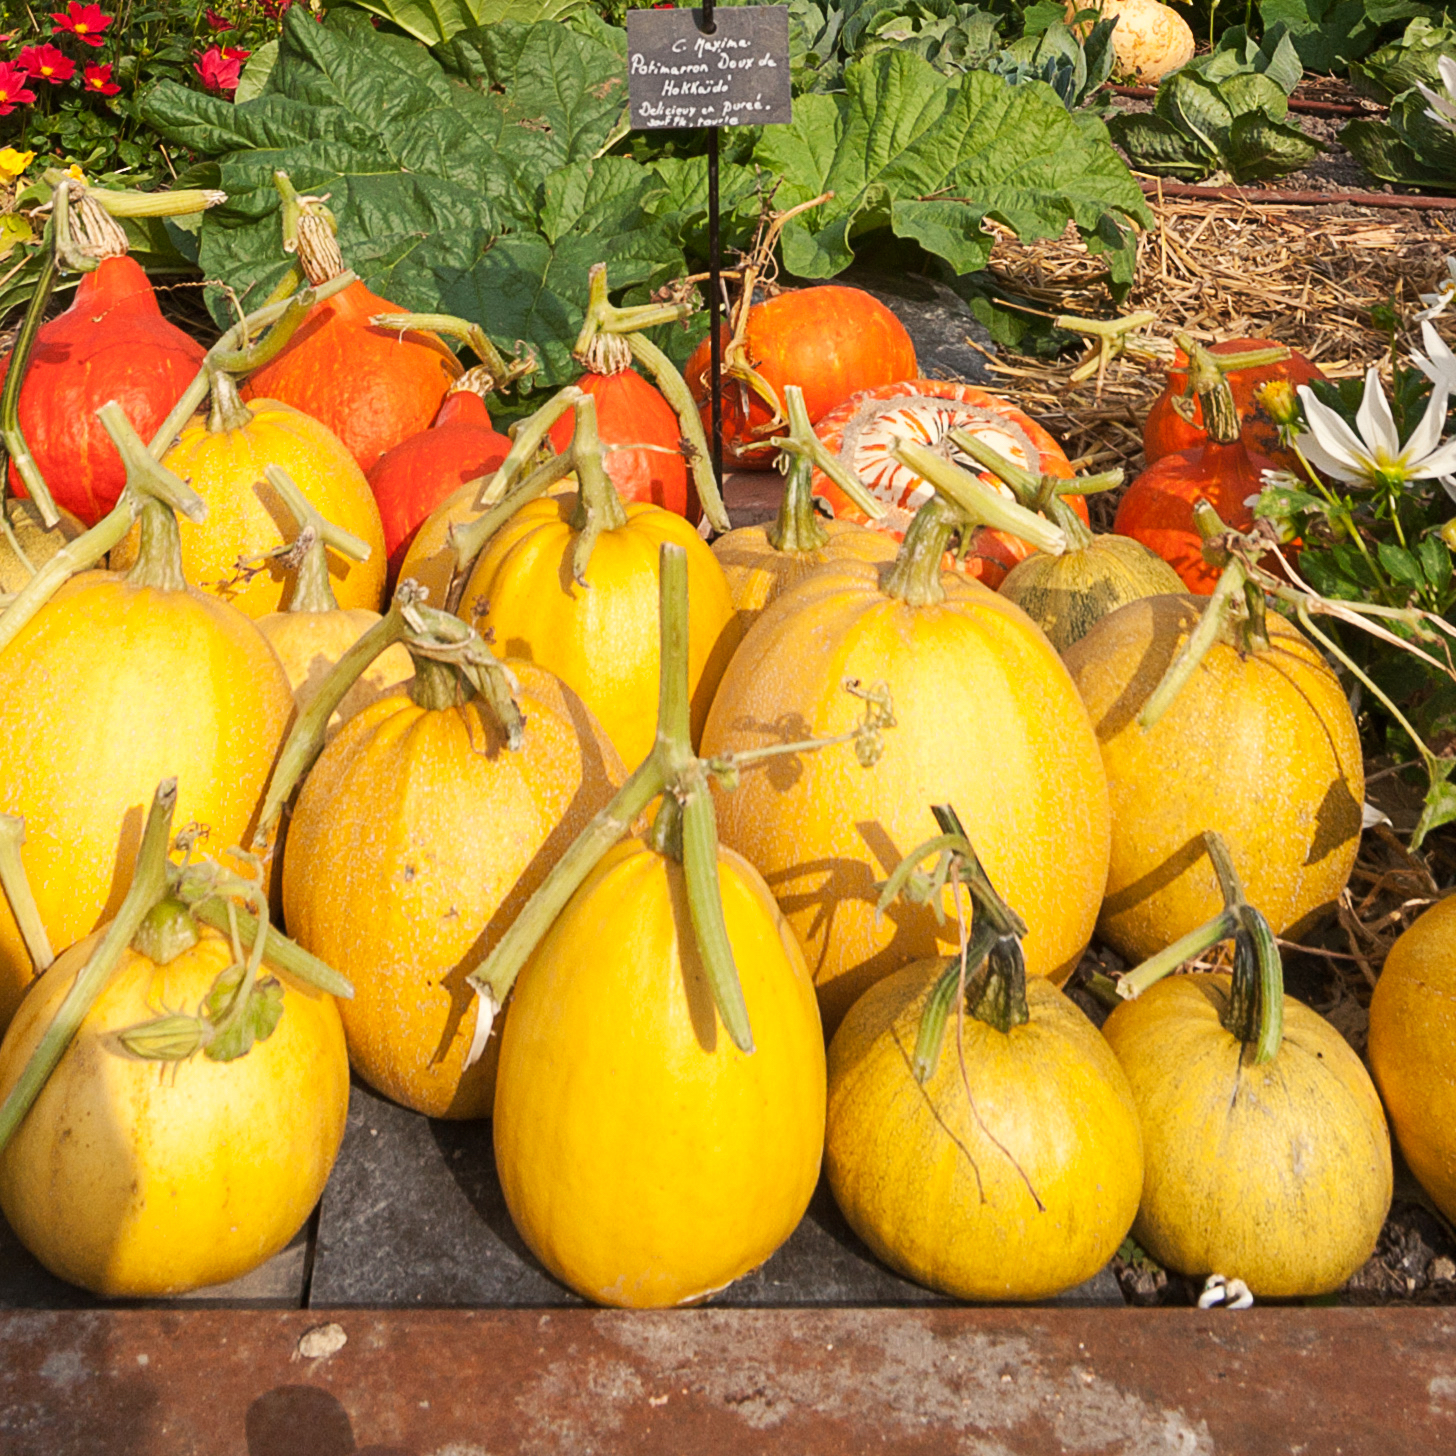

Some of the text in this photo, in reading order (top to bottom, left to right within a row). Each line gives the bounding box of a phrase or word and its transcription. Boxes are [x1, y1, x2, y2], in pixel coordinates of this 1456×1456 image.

[631, 52, 777, 75] Potimarron Doux de
[701, 106, 714, 114] en
